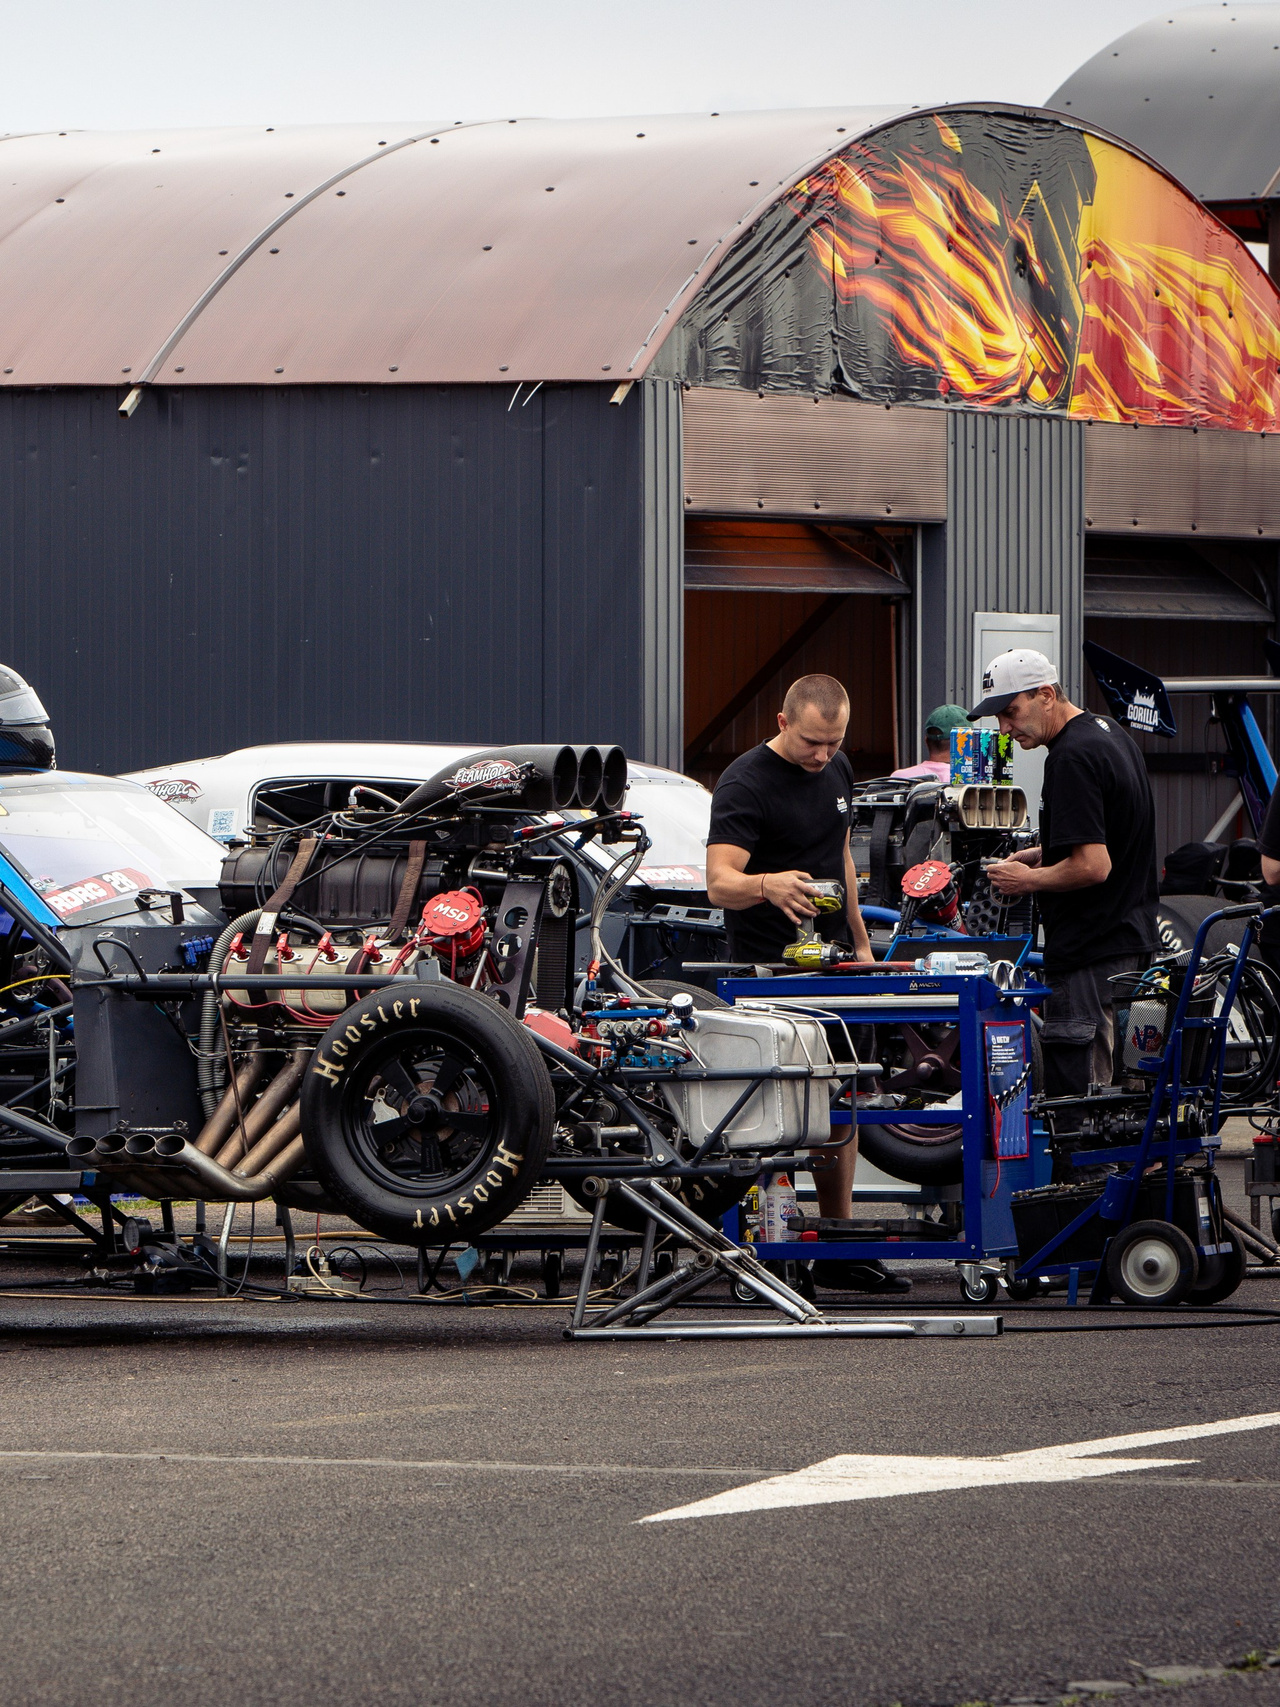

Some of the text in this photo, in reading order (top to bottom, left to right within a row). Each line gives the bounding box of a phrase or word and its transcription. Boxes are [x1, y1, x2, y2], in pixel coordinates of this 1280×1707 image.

[1127, 704, 1158, 726] GORILLA
[1130, 721, 1154, 732] ENERGY DRINK
[454, 765, 511, 783] FLAMHOLC
[102, 871, 139, 893] 28
[914, 866, 937, 890] MSD
[433, 903, 469, 922] MSD
[312, 998, 421, 1088] Hoosier
[413, 1139, 524, 1229] Hoosier
